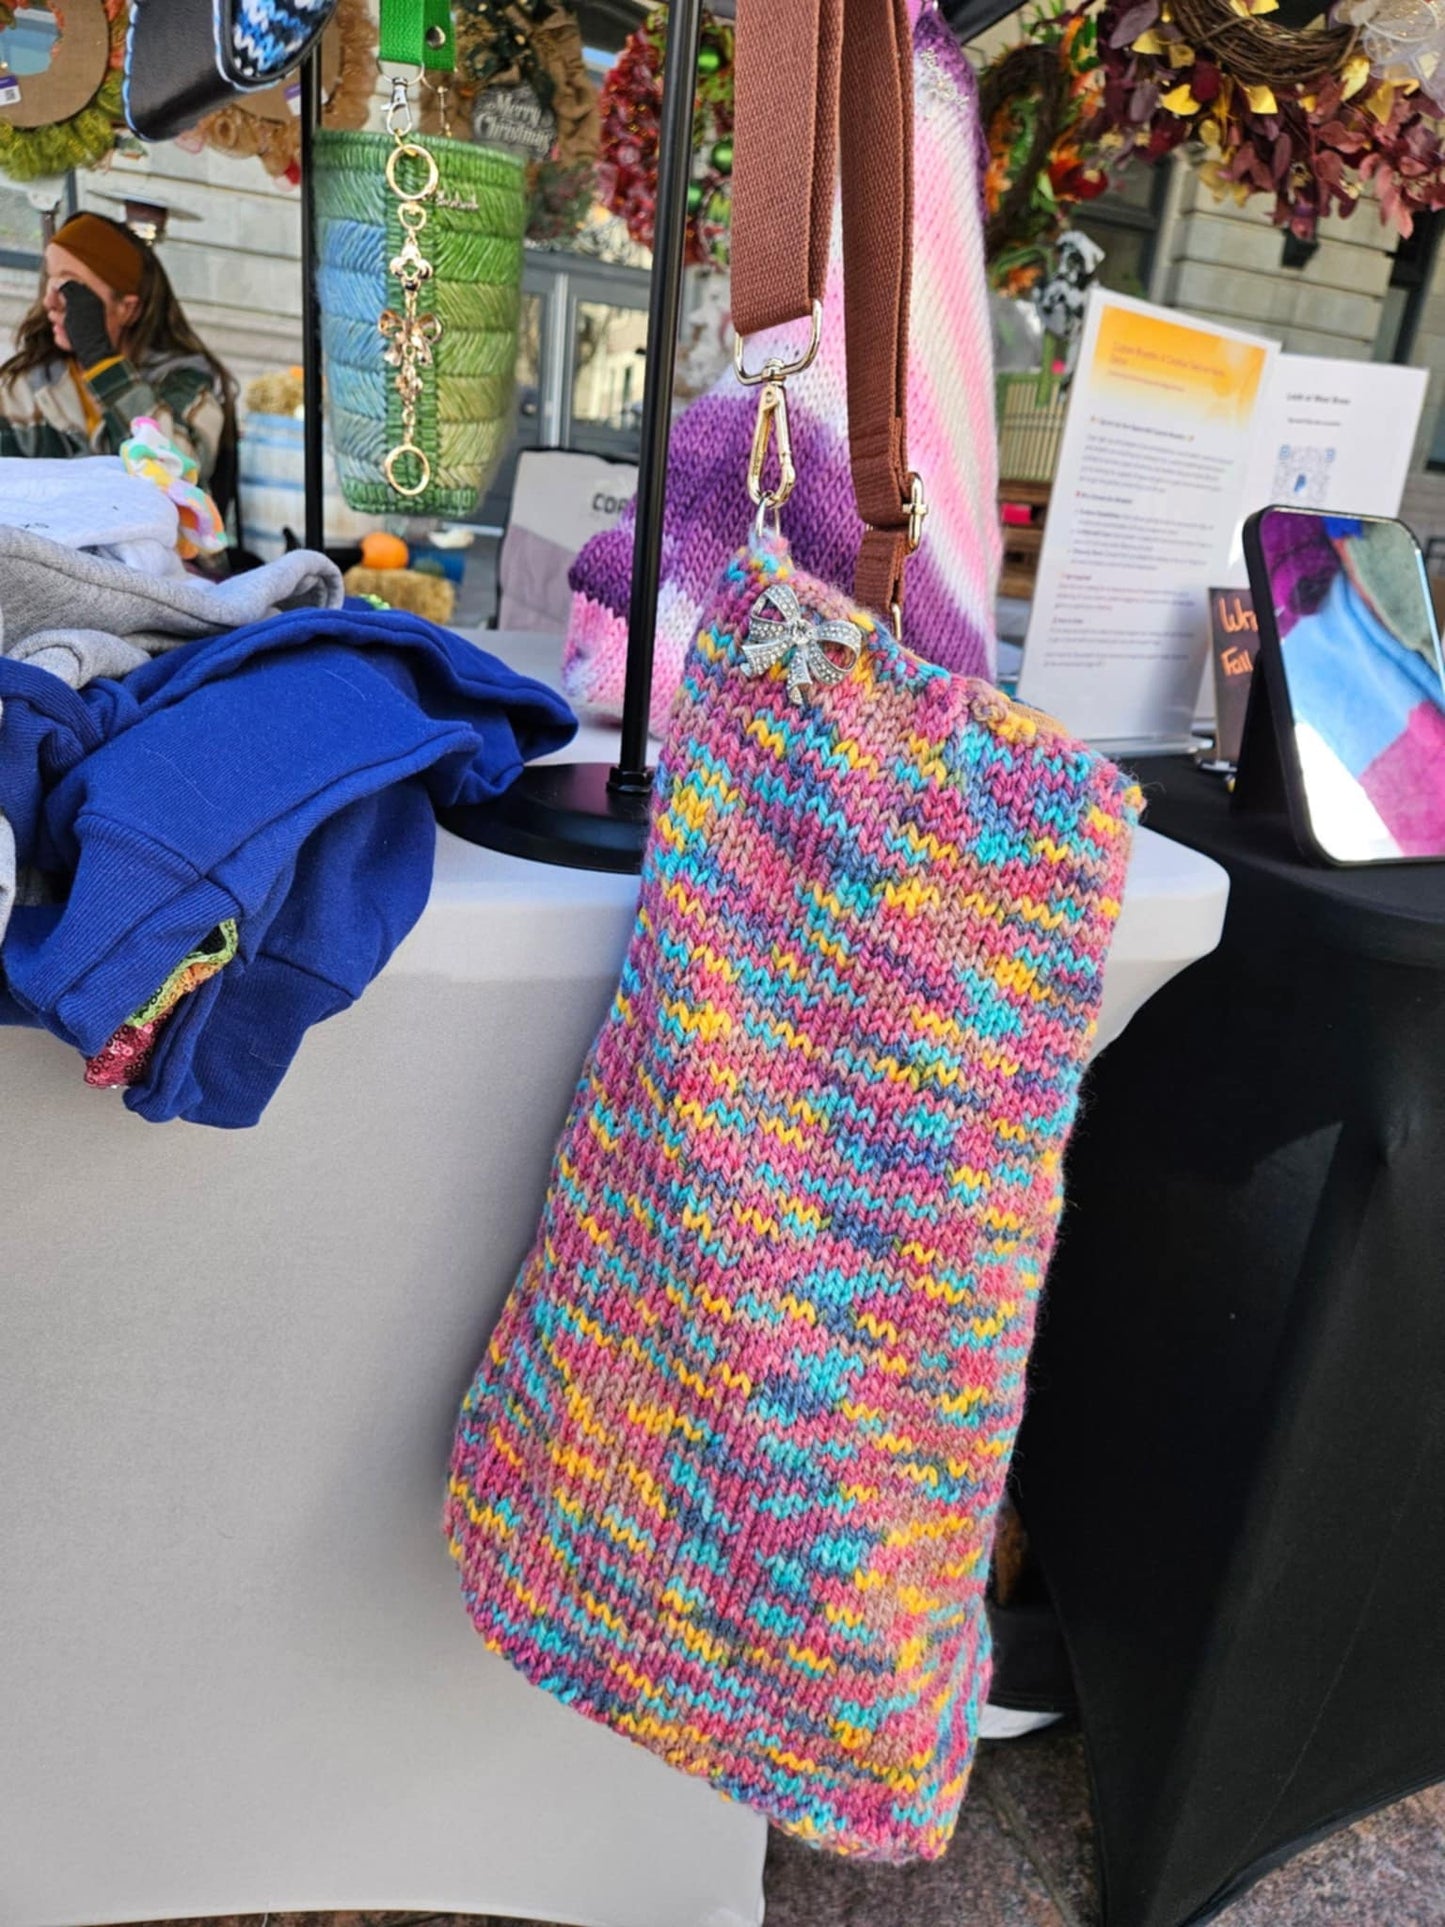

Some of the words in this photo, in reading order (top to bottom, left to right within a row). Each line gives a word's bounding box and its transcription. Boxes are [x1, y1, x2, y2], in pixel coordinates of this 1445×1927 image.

[487, 90, 541, 128] Merry
[474, 112, 551, 152] Christmas
[1221, 646, 1254, 676] Fall
